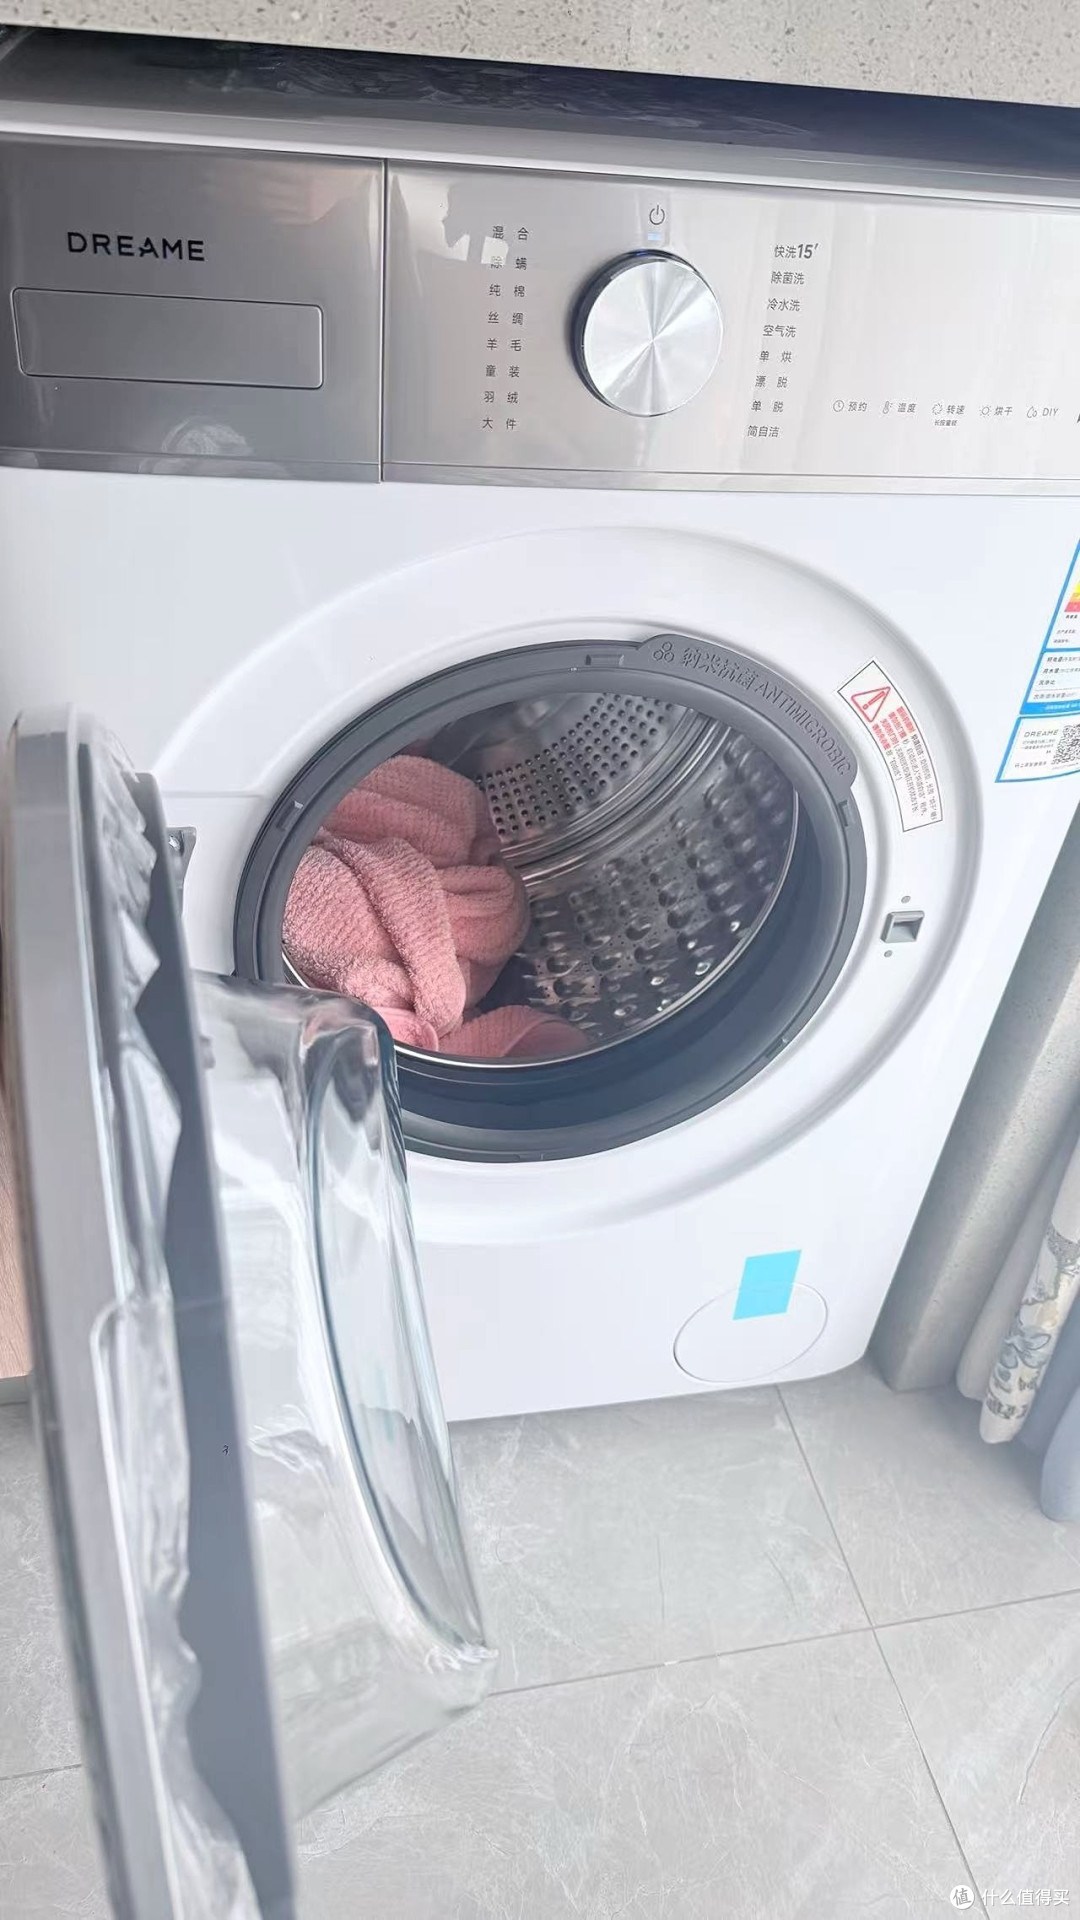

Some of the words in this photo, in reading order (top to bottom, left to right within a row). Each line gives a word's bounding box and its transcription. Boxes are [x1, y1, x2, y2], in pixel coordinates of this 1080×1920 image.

[492, 225, 529, 241] 混合
[67, 231, 206, 262] DREAME
[770, 271, 805, 285] 除菌洗
[489, 284, 525, 298] 纯棉
[766, 298, 801, 312] 冷水洗
[487, 311, 524, 326] 丝绸
[762, 324, 797, 338] 空气洗
[486, 338, 522, 352] 羊毛
[759, 350, 792, 363] 单烘
[485, 364, 520, 378] 童装
[483, 391, 519, 404] 羽绒
[751, 401, 784, 413] 单脱
[847, 401, 868, 412] 预约
[897, 402, 917, 414] 温度
[946, 405, 966, 415] 转速
[994, 406, 1013, 417] 烘干
[1042, 407, 1059, 417] DIY
[482, 417, 516, 430] 大件
[1024, 730, 1059, 738] DREAME
